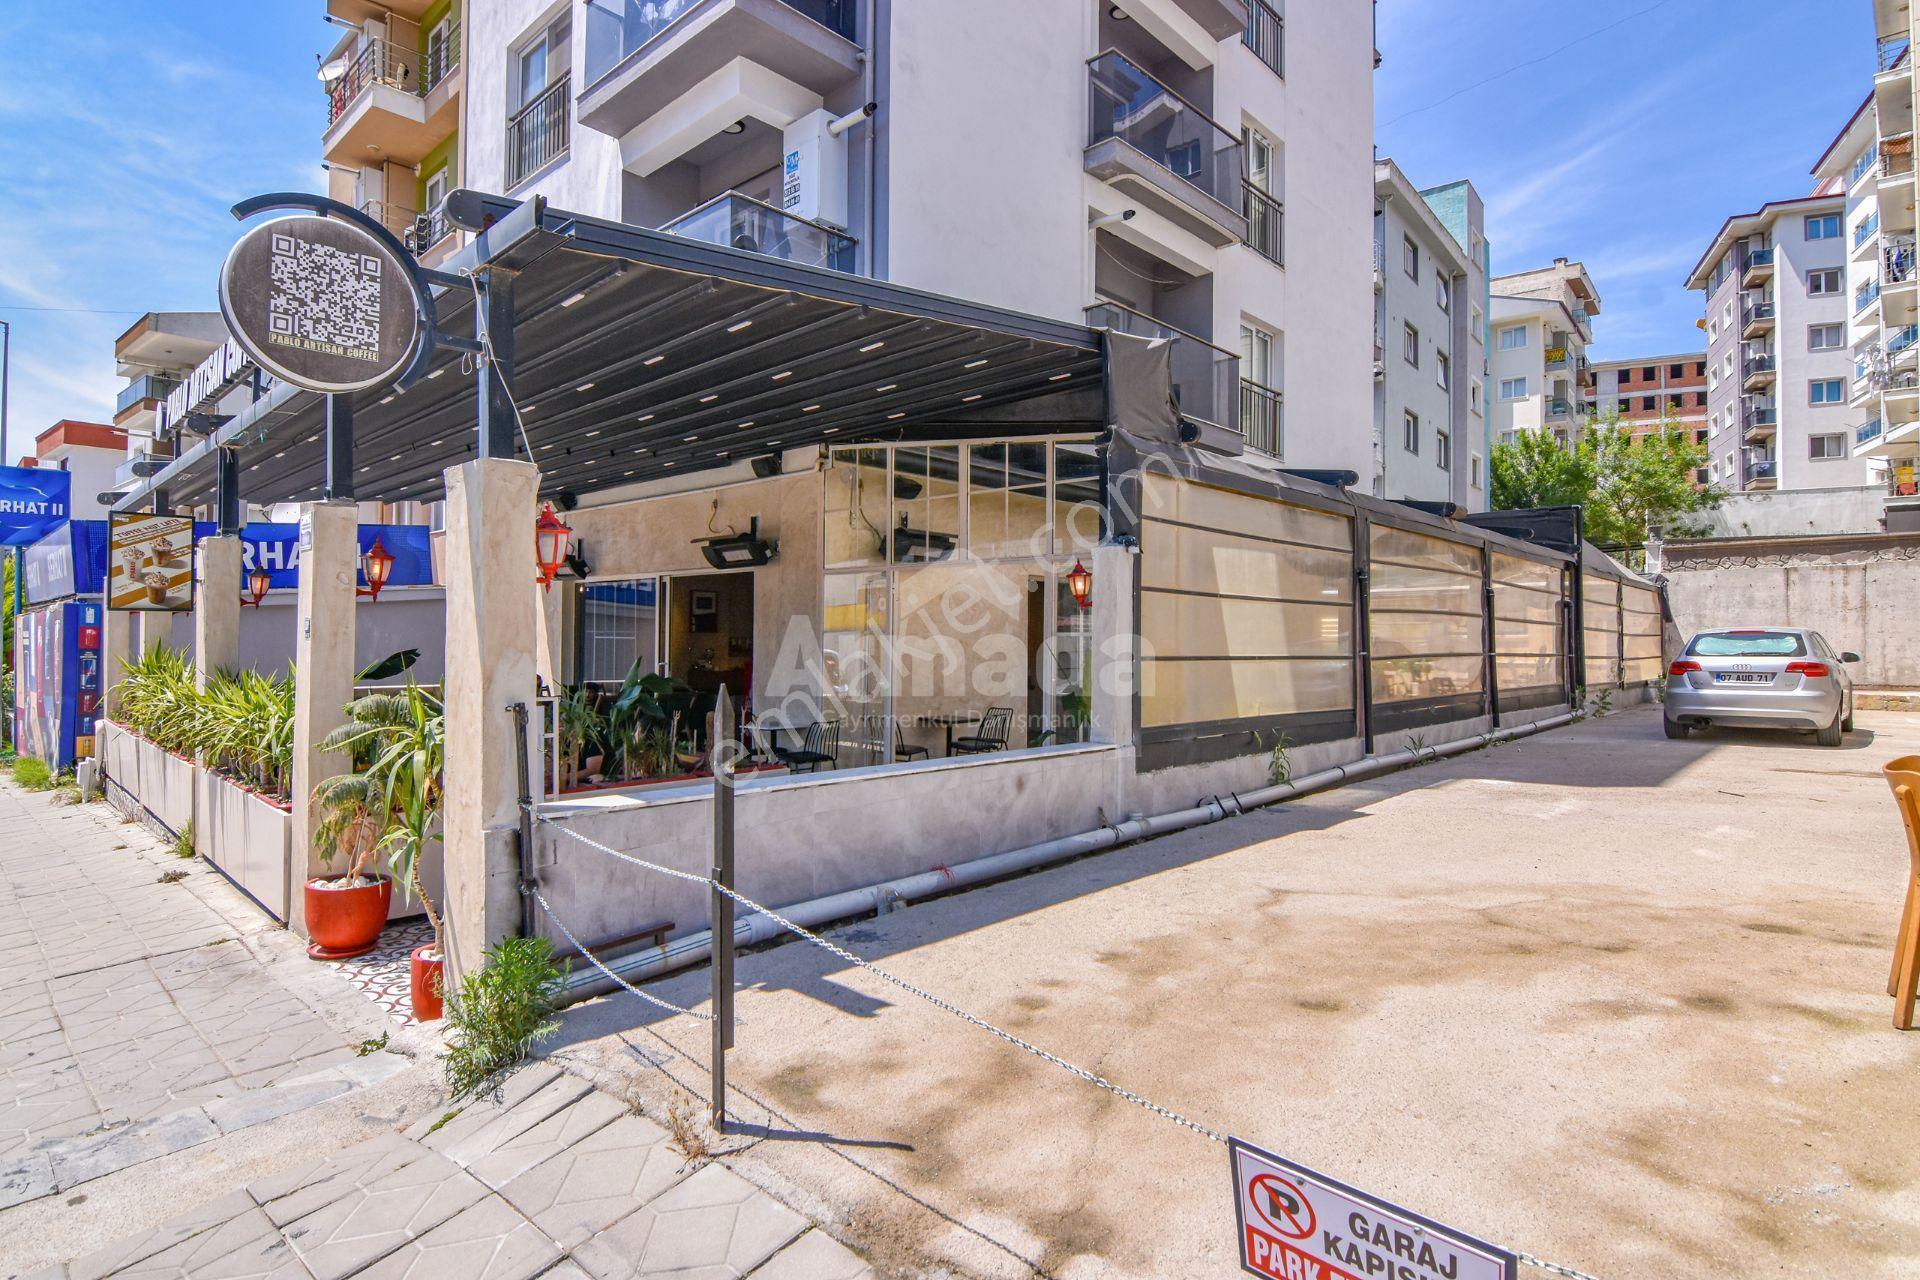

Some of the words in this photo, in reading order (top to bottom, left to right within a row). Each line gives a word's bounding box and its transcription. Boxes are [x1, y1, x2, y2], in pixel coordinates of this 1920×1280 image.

[271, 333, 301, 347] PABLO
[303, 340, 344, 355] ARTISAN
[346, 347, 378, 361] COFFEE
[242, 541, 300, 570] RHA
[1720, 674, 1732, 682] 07
[1757, 674, 1769, 682] 71
[1323, 1230, 1428, 1280] KAPIS
[1348, 1212, 1457, 1280] GARAJ
